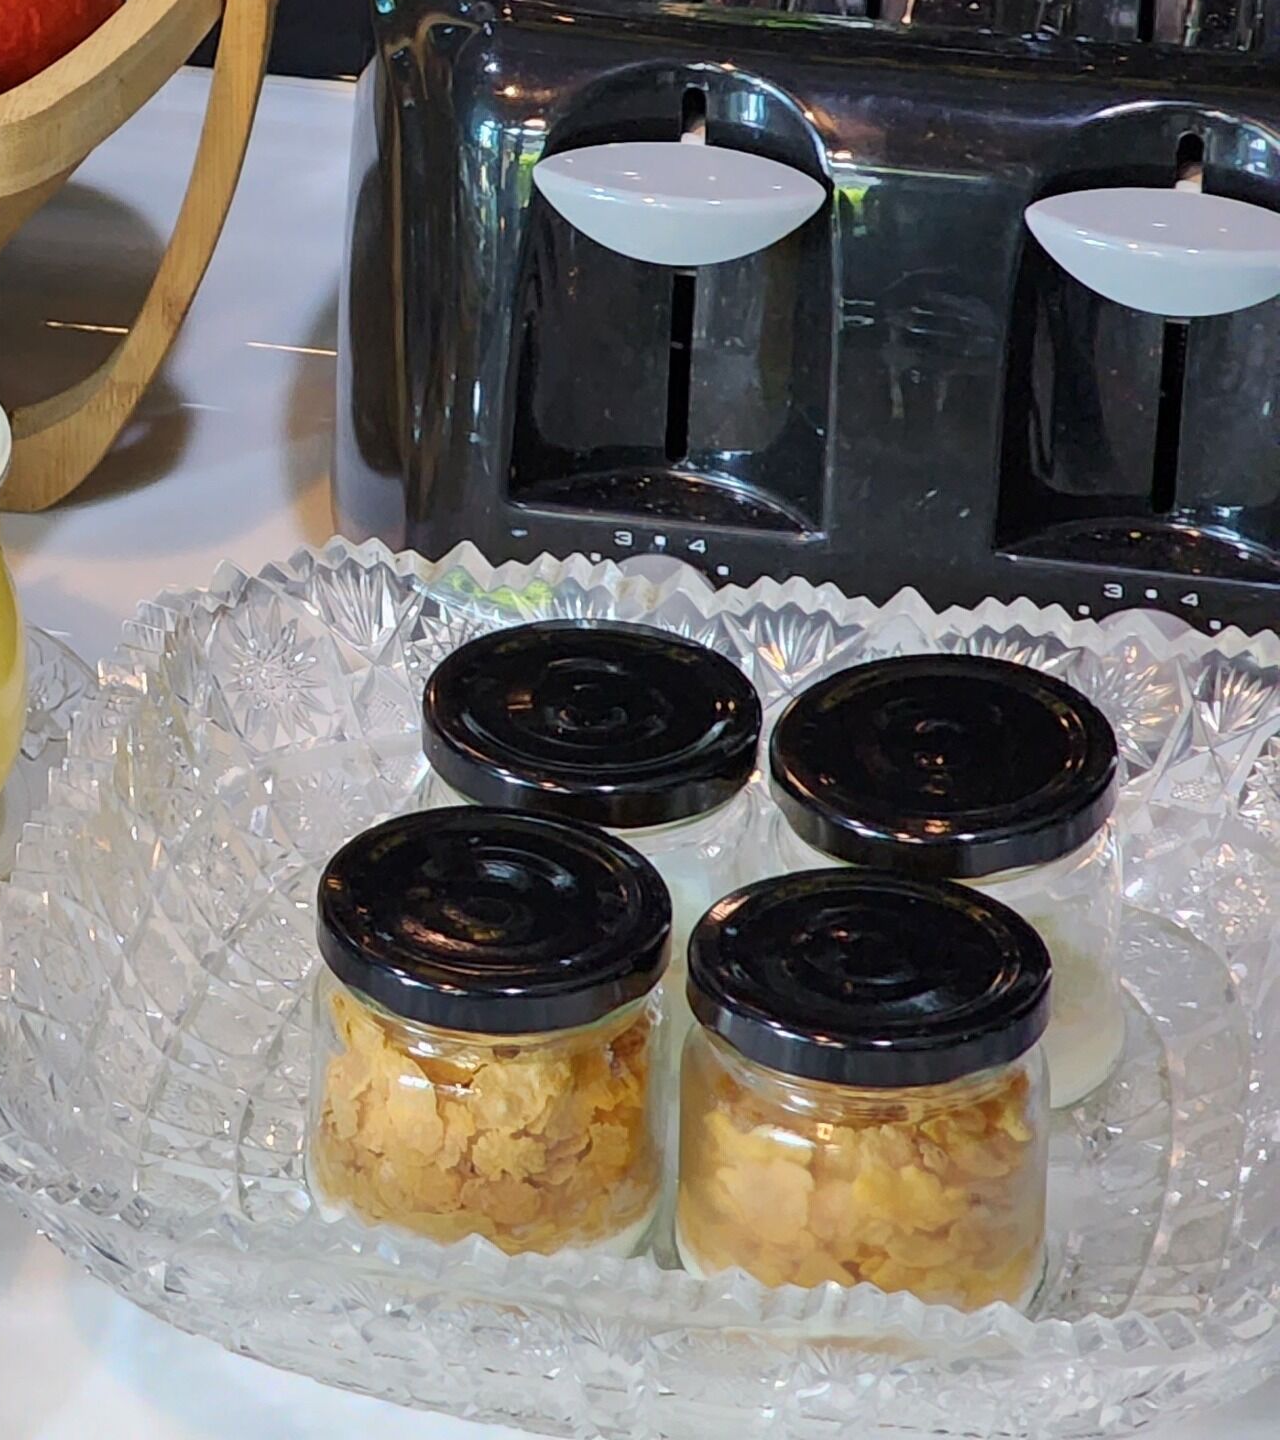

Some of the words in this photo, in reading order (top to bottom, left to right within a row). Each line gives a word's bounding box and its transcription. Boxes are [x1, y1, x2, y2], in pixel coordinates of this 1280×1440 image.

[613, 530, 633, 546] 3
[688, 539, 707, 554] 4
[1103, 583, 1124, 599] 3
[1180, 593, 1199, 607] 4
